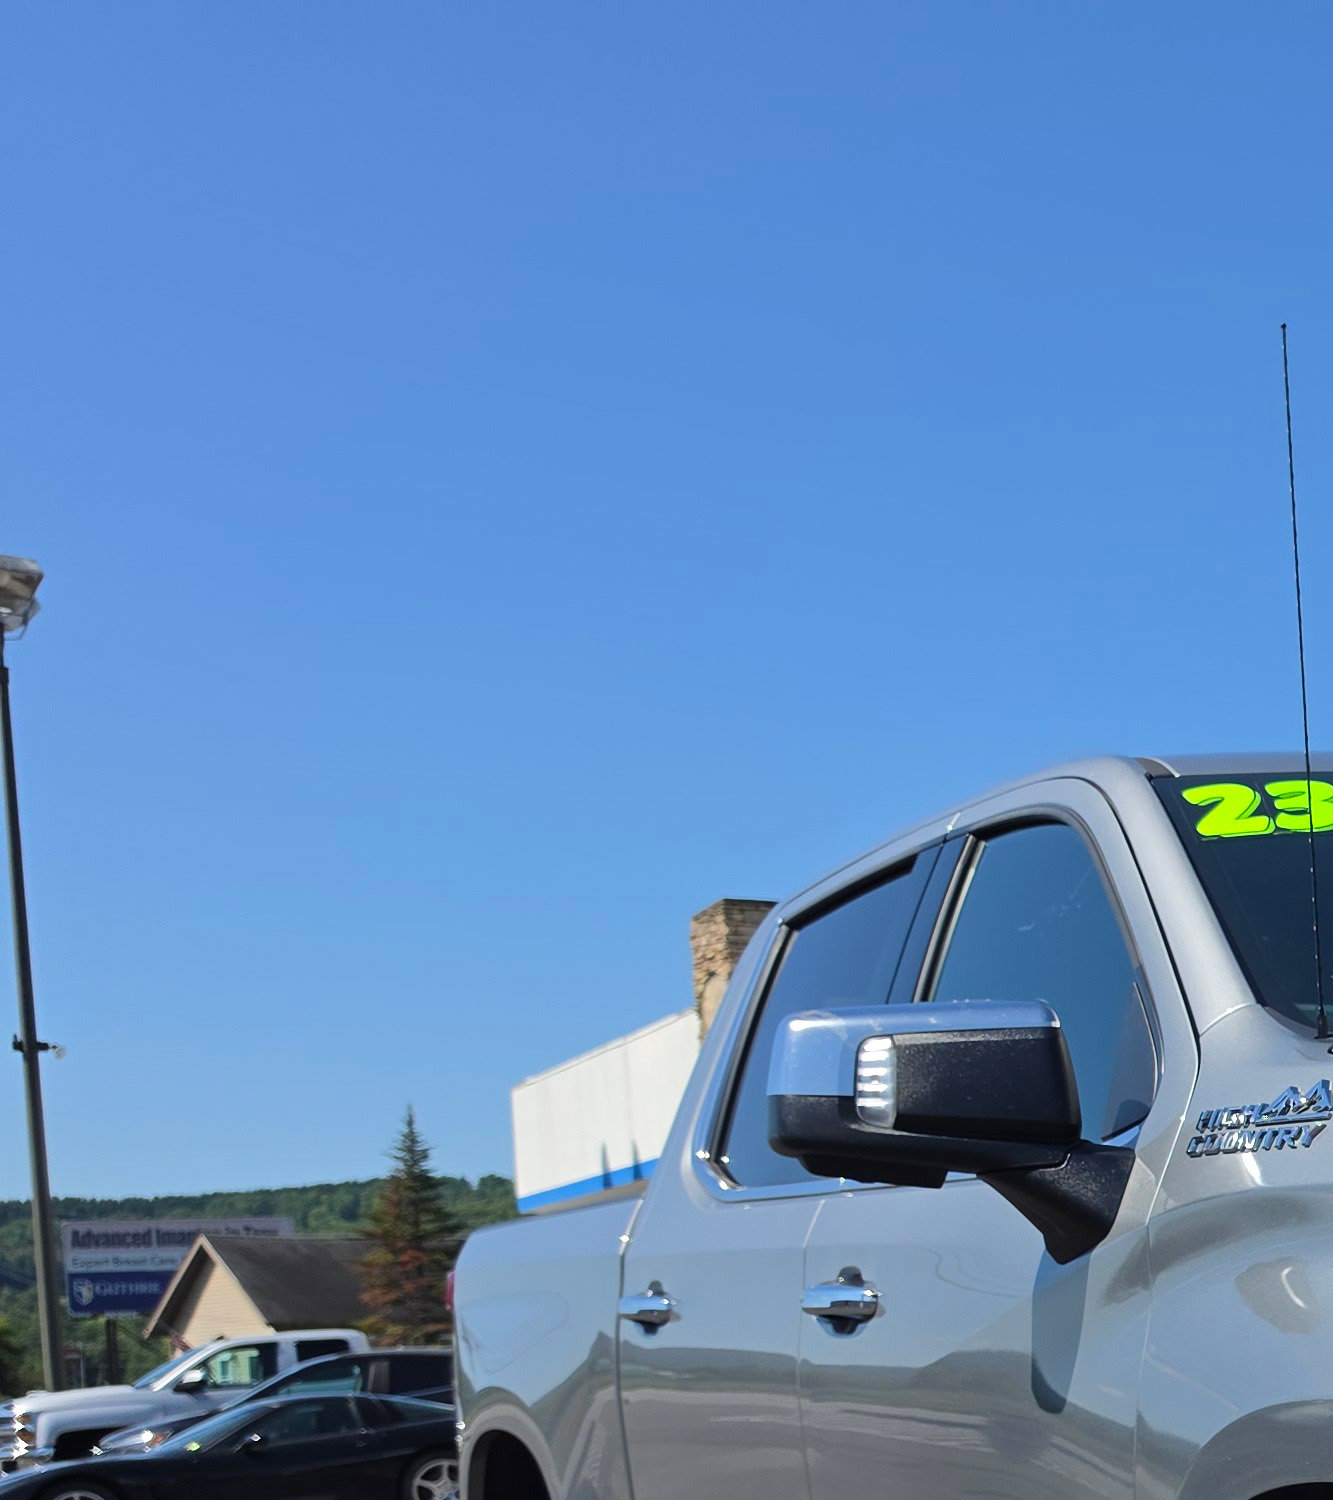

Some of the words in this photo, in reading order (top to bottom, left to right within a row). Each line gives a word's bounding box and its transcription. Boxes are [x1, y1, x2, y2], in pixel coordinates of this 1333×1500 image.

[1196, 1103, 1268, 1133] HIGH
[1187, 1123, 1327, 1158] COUNTRY
[70, 1228, 153, 1248] Advanced
